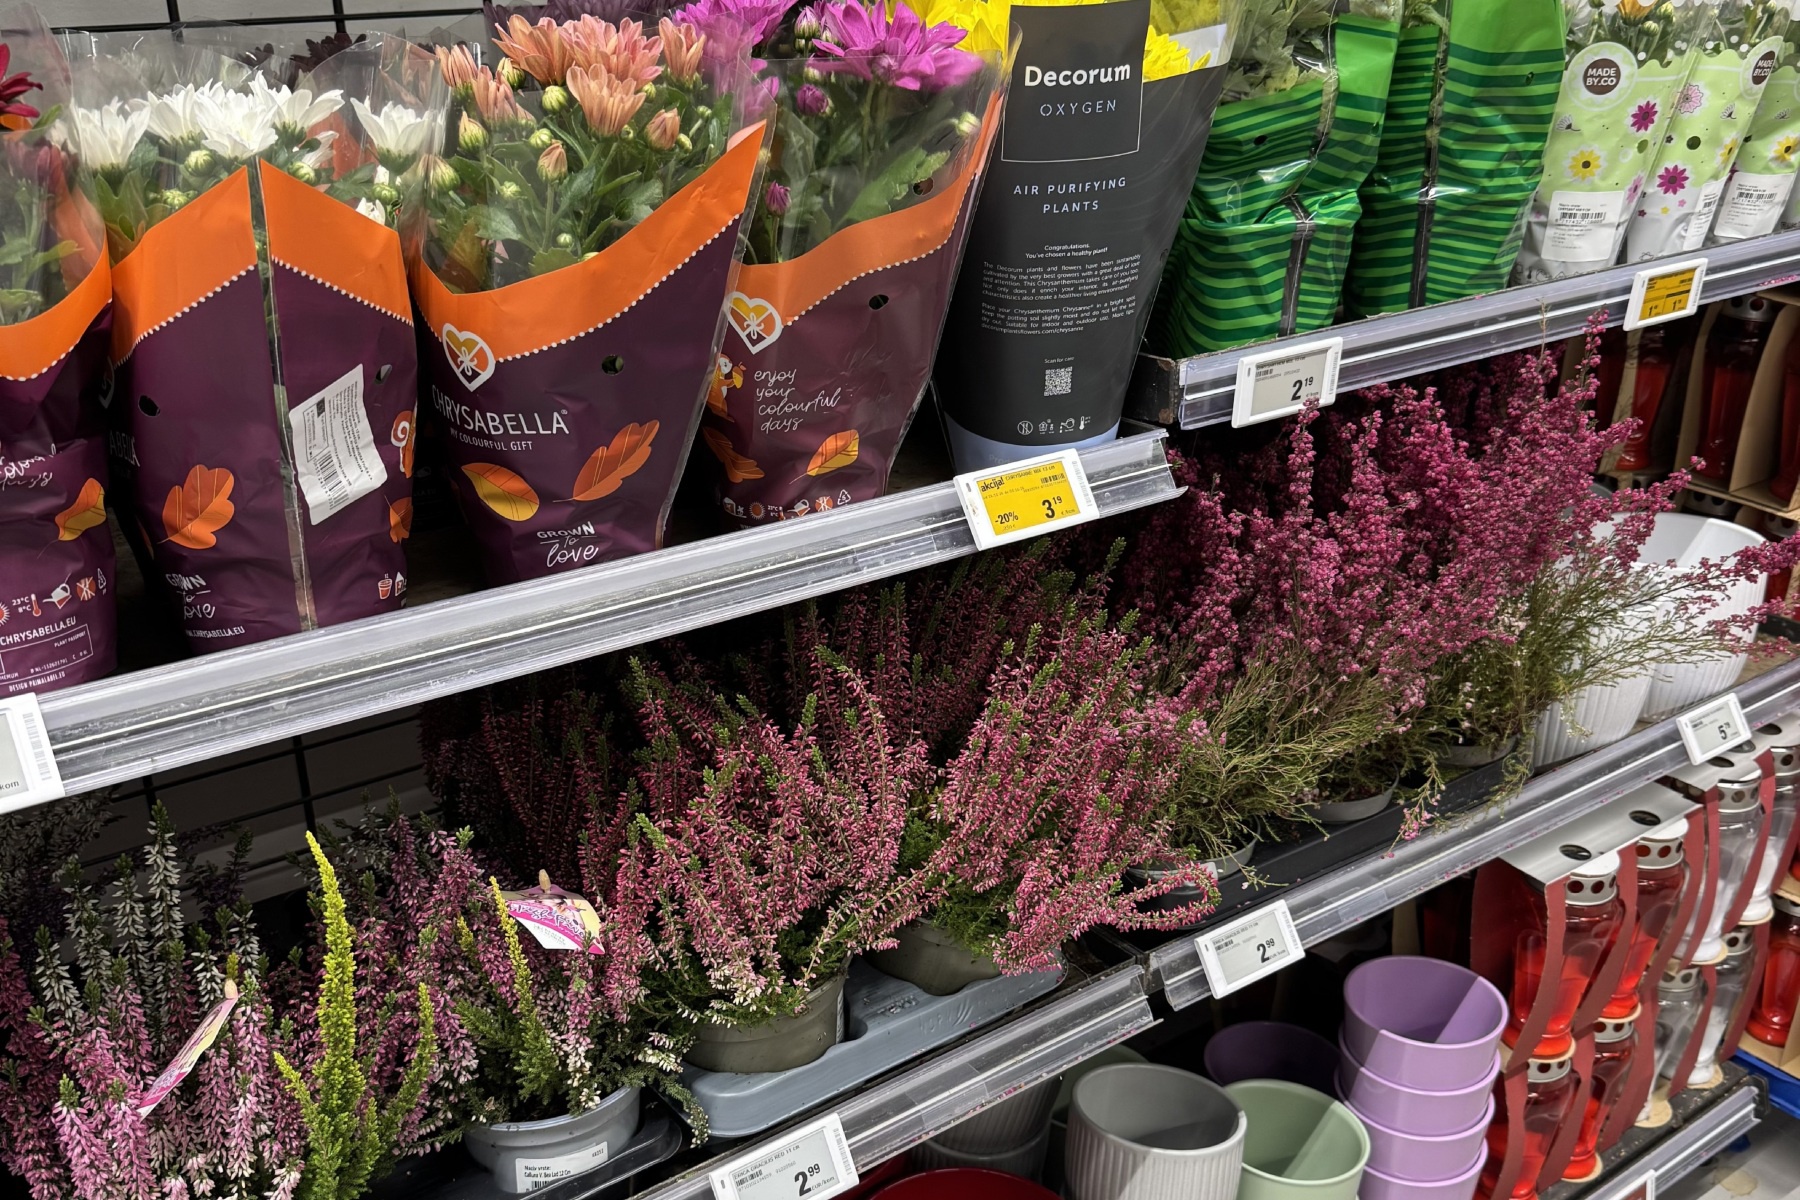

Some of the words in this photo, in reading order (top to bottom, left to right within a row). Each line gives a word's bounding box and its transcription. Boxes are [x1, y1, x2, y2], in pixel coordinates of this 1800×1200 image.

[1024, 64, 1131, 87] Decorum
[1587, 68, 1617, 77] MADE
[1586, 77, 1617, 86] BY.CO
[1040, 99, 1117, 117] OXYGEN
[1013, 185, 1039, 195] AIR
[1047, 177, 1126, 194] PURIFYING
[1043, 200, 1099, 214] PLANTS
[997, 264, 1023, 273] Decorum
[1057, 271, 1080, 279] growers
[1037, 279, 1085, 287] Chrysanthemum
[1110, 298, 1124, 306] bright
[754, 368, 797, 387] enjoy
[756, 387, 796, 402] your
[1291, 379, 1303, 401] 2
[1304, 376, 1314, 387] 19
[758, 387, 842, 416] colourful
[760, 417, 804, 434] days
[459, 432, 508, 450] COLOURFUL
[510, 441, 533, 451] GIFT
[980, 477, 1005, 492] akcija!
[1041, 499, 1056, 519] 3
[1052, 495, 1063, 505] 19
[995, 511, 1019, 525] -20%
[536, 521, 595, 539] GROWN
[546, 543, 599, 567] love
[54, 638, 68, 648] PLANT
[68, 630, 86, 643] PASSPORT
[8, 682, 28, 692] DESIGN
[1717, 724, 1728, 740] 5
[1256, 943, 1270, 963] 2
[1265, 938, 1276, 949] 99
[794, 1171, 812, 1197] 2
[807, 1163, 821, 1177] 99
